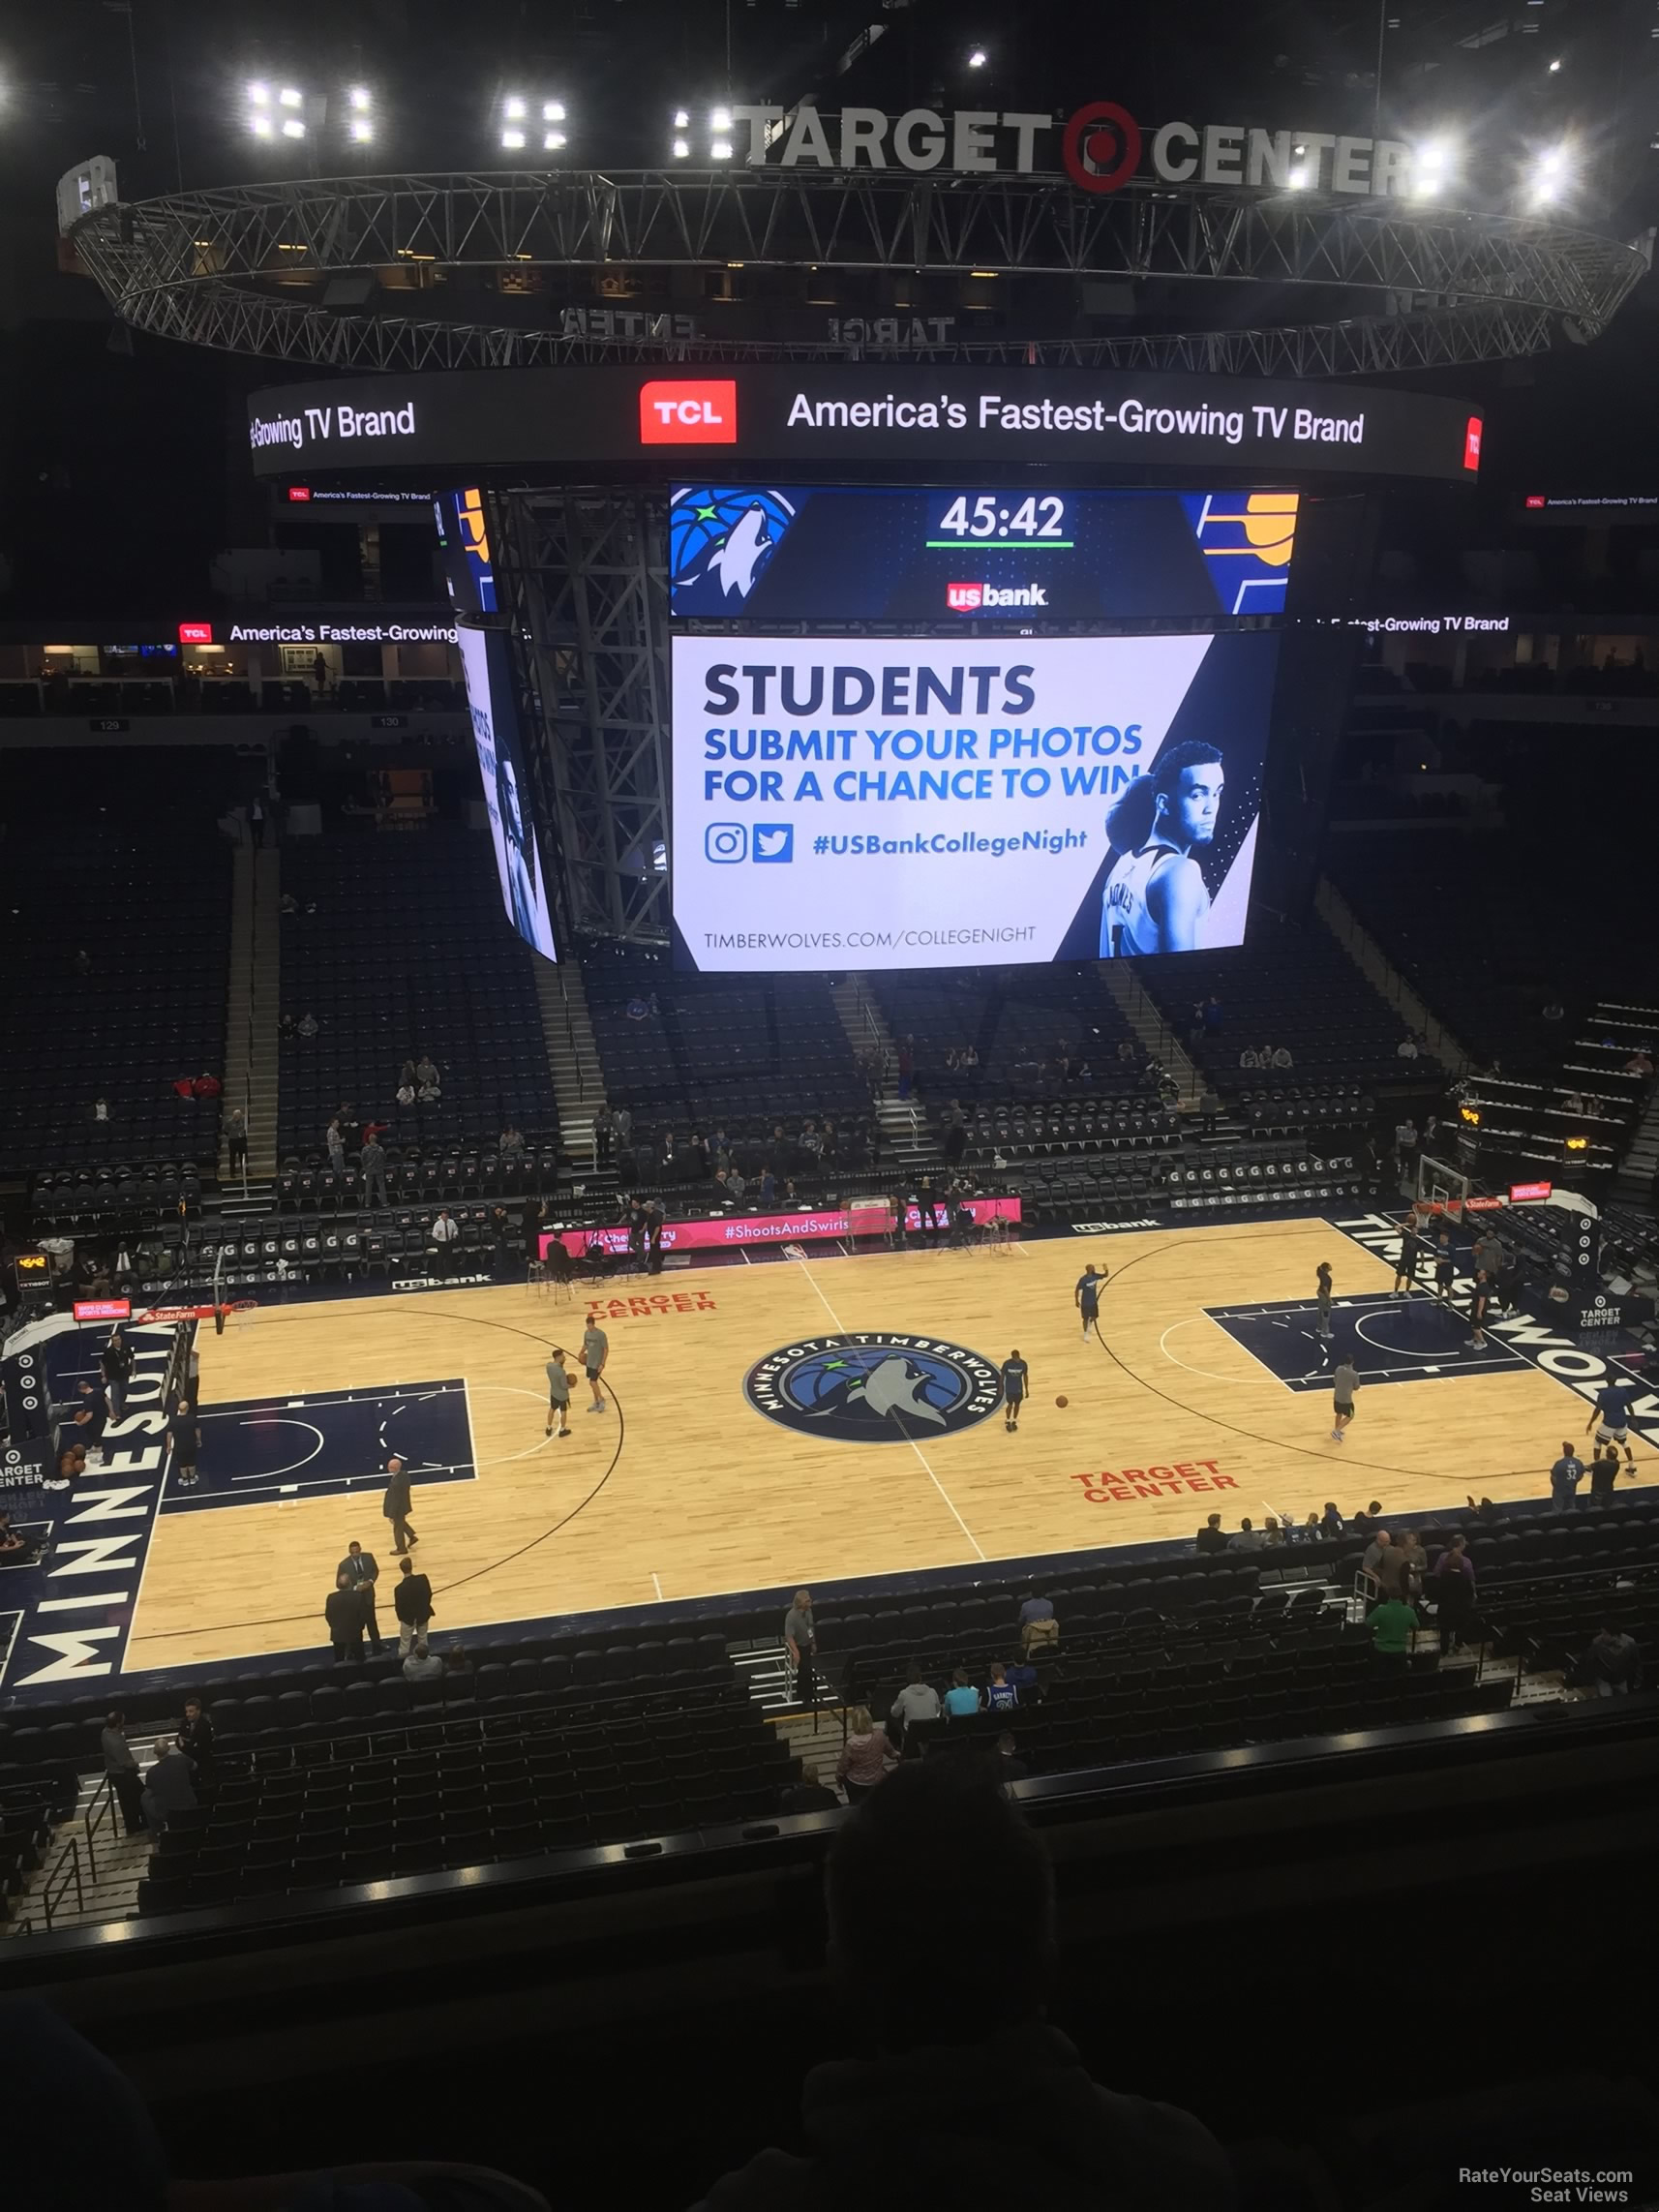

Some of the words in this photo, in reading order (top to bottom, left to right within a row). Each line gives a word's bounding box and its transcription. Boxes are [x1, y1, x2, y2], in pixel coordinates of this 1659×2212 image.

[734, 105, 1052, 174] TARGET
[1153, 121, 1411, 196] CENTER
[305, 408, 331, 439] TV
[338, 402, 415, 438] Brand
[653, 402, 723, 424] TCL
[979, 396, 1243, 444] Fastest-Growing
[1252, 407, 1288, 440] TV
[1293, 410, 1365, 444] Brand
[347, 492, 400, 500] Fastest-Growing
[939, 496, 1064, 538] 45:42
[184, 629, 207, 638] TCL
[319, 624, 459, 643] Fastest-Growing
[1443, 617, 1462, 630] TV
[1463, 617, 1509, 631] Brand
[704, 664, 1036, 715] STUDENTS
[100, 720, 120, 731] 129
[380, 716, 399, 727] 130
[704, 729, 858, 761] SUBMIT
[865, 728, 979, 761] YOUR
[989, 724, 1142, 760] PHOTOS
[704, 771, 785, 802] FOR
[794, 771, 824, 802] A
[832, 769, 992, 802] CHANCE
[1001, 767, 1049, 800] TO
[1061, 764, 1139, 796] WIN
[812, 830, 1087, 858] #USBankCollegeNight
[704, 925, 1036, 950] TIMBERWOLVES.COM/COLLEGENIGHT
[725, 1216, 850, 1239] #ShootsAndSwirls
[584, 1290, 711, 1311] TARGET
[588, 1301, 717, 1320] CENTER
[1581, 1307, 1621, 1318] TARGET
[1580, 1317, 1621, 1327] CENTER
[754, 1339, 841, 1411] MINNESOTA
[856, 1335, 998, 1413] TIMBERWOLVES
[1070, 1461, 1220, 1488] TARGET
[1566, 1469, 1577, 1480] 32
[1084, 1475, 1241, 1503] CENTER
